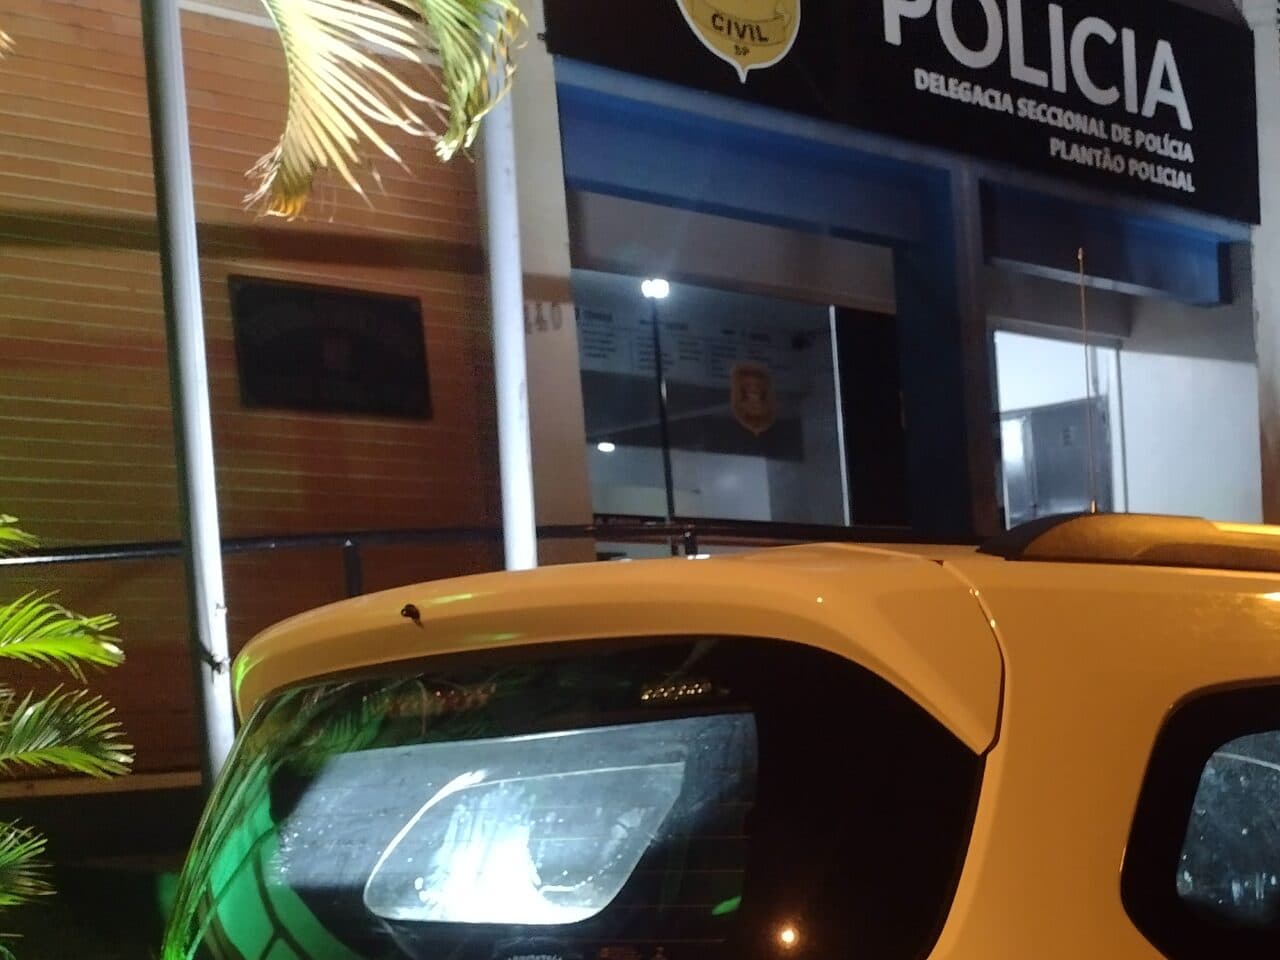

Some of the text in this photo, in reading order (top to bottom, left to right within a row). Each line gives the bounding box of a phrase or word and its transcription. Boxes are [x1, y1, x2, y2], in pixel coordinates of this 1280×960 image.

[711, 13, 769, 42] CIVIL
[913, 68, 1195, 163] DELEGACIA SECCIONAL DE POLÍCIA
[1050, 137, 1196, 193] PLANTÃO POLICIAL
